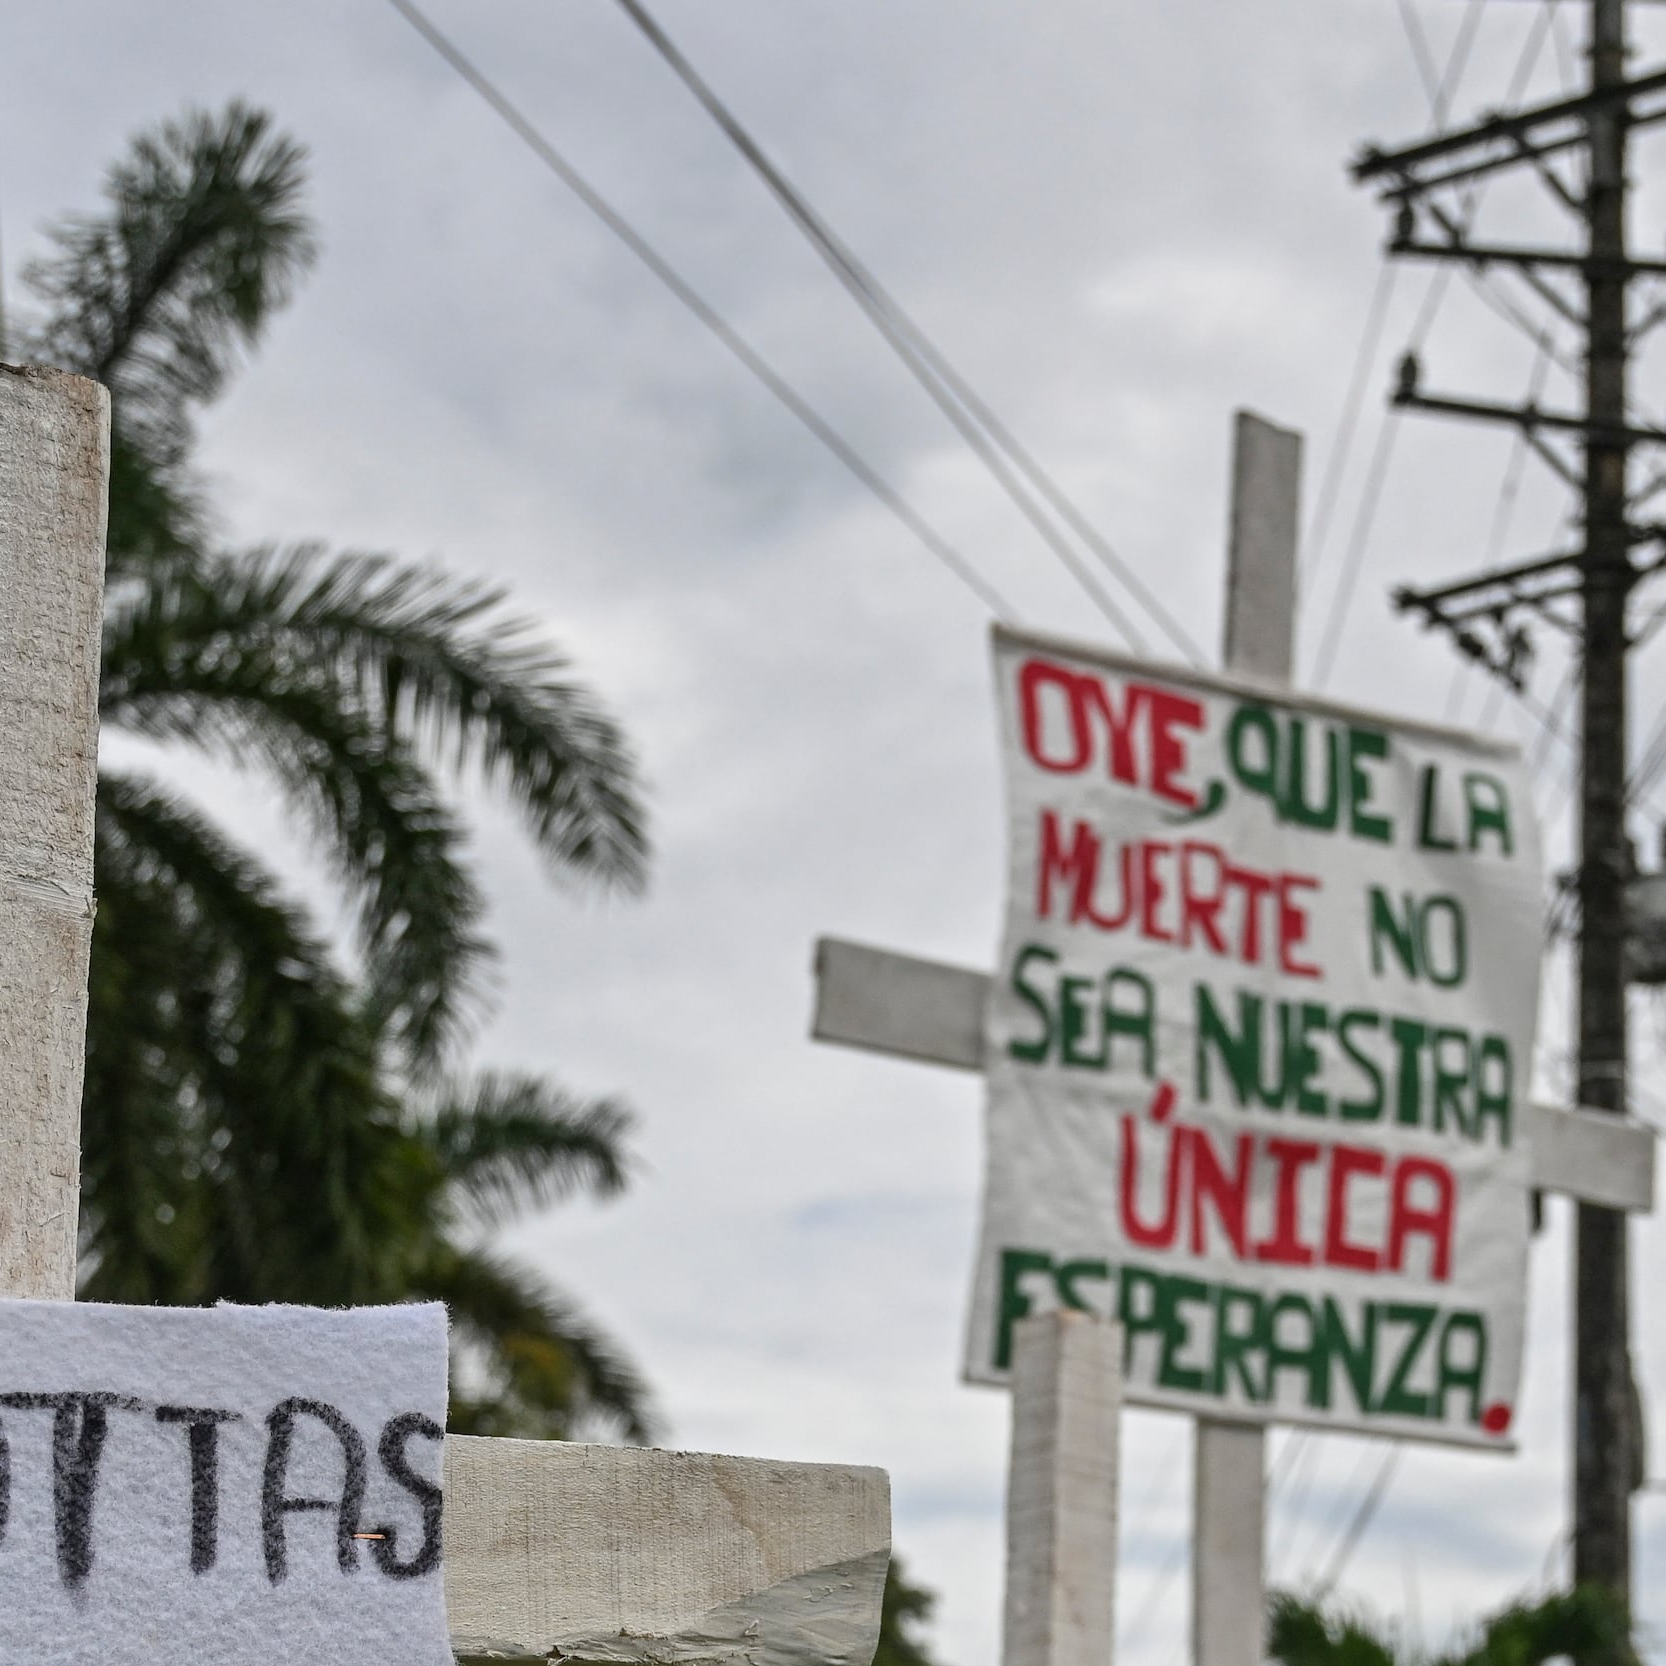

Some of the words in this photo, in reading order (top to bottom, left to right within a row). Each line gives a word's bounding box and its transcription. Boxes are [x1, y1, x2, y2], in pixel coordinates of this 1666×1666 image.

[1226, 702, 1393, 846] QUE
[1414, 763, 1514, 857] LA
[1036, 808, 1323, 980] MUERTE
[1368, 886, 1469, 988] NO
[1008, 944, 1156, 1078] SEA
[1194, 981, 1513, 1147] NUESTRA
[1117, 1080, 1457, 1283] ÚNICA
